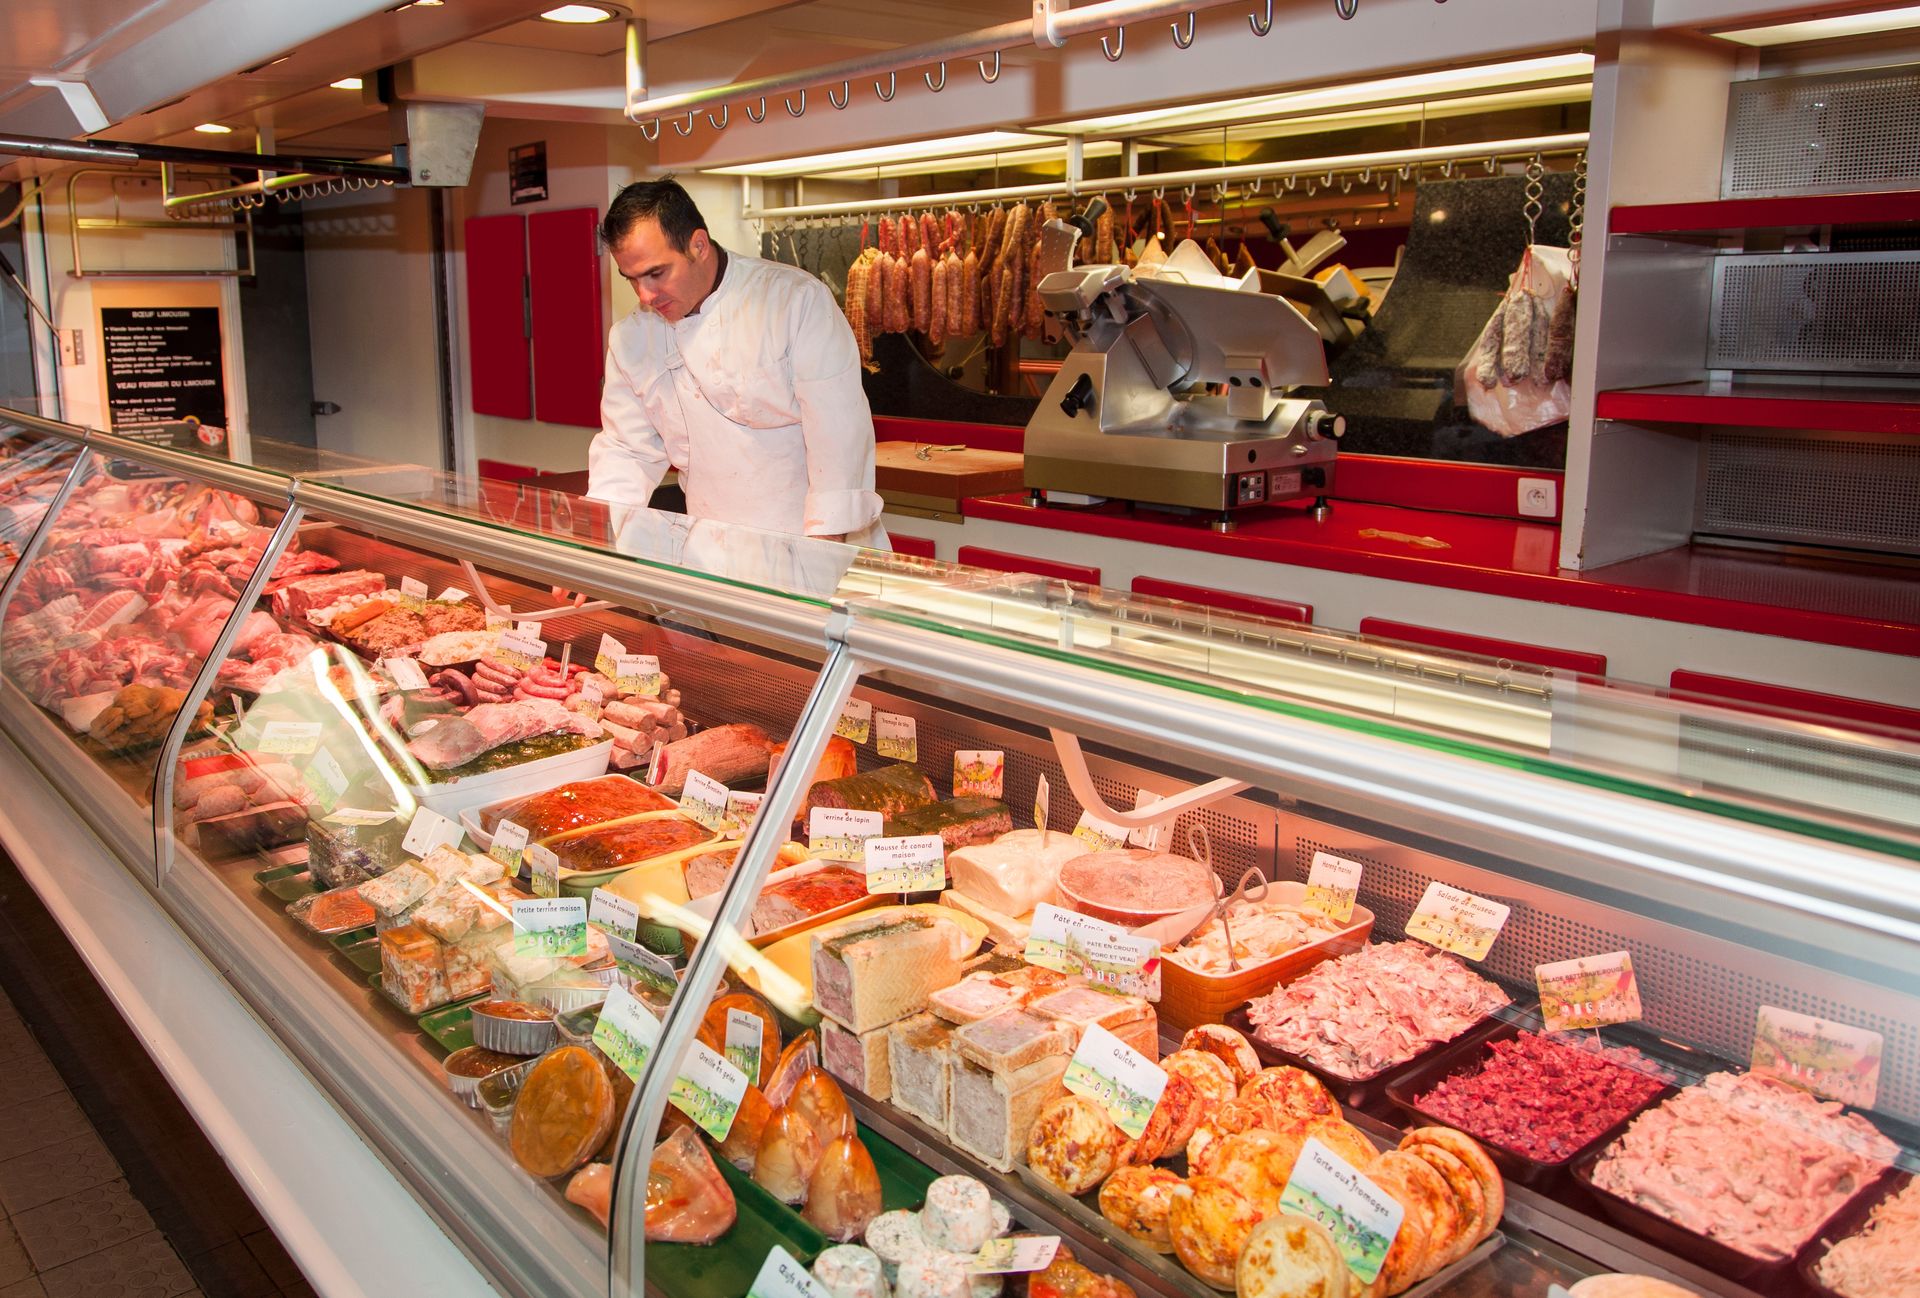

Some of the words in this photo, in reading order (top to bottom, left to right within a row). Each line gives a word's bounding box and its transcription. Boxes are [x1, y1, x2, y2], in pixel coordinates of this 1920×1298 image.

[855, 816, 869, 824] lapin
[1436, 890, 1459, 904] Salade
[1471, 903, 1497, 916] museau
[1054, 913, 1070, 924] Pâté
[1460, 908, 1475, 918] porc
[1114, 945, 1138, 953] CROUTE
[1541, 976, 1563, 984] SALADE
[1602, 966, 1624, 974] ROUGE
[1780, 1027, 1808, 1038] SALADE
[699, 1051, 716, 1069] Oreille
[716, 1065, 723, 1074] en
[1113, 1048, 1136, 1069] Quiche
[1313, 1152, 1333, 1172] Tarte
[1334, 1171, 1350, 1184] aux
[1348, 1182, 1389, 1217] fromages
